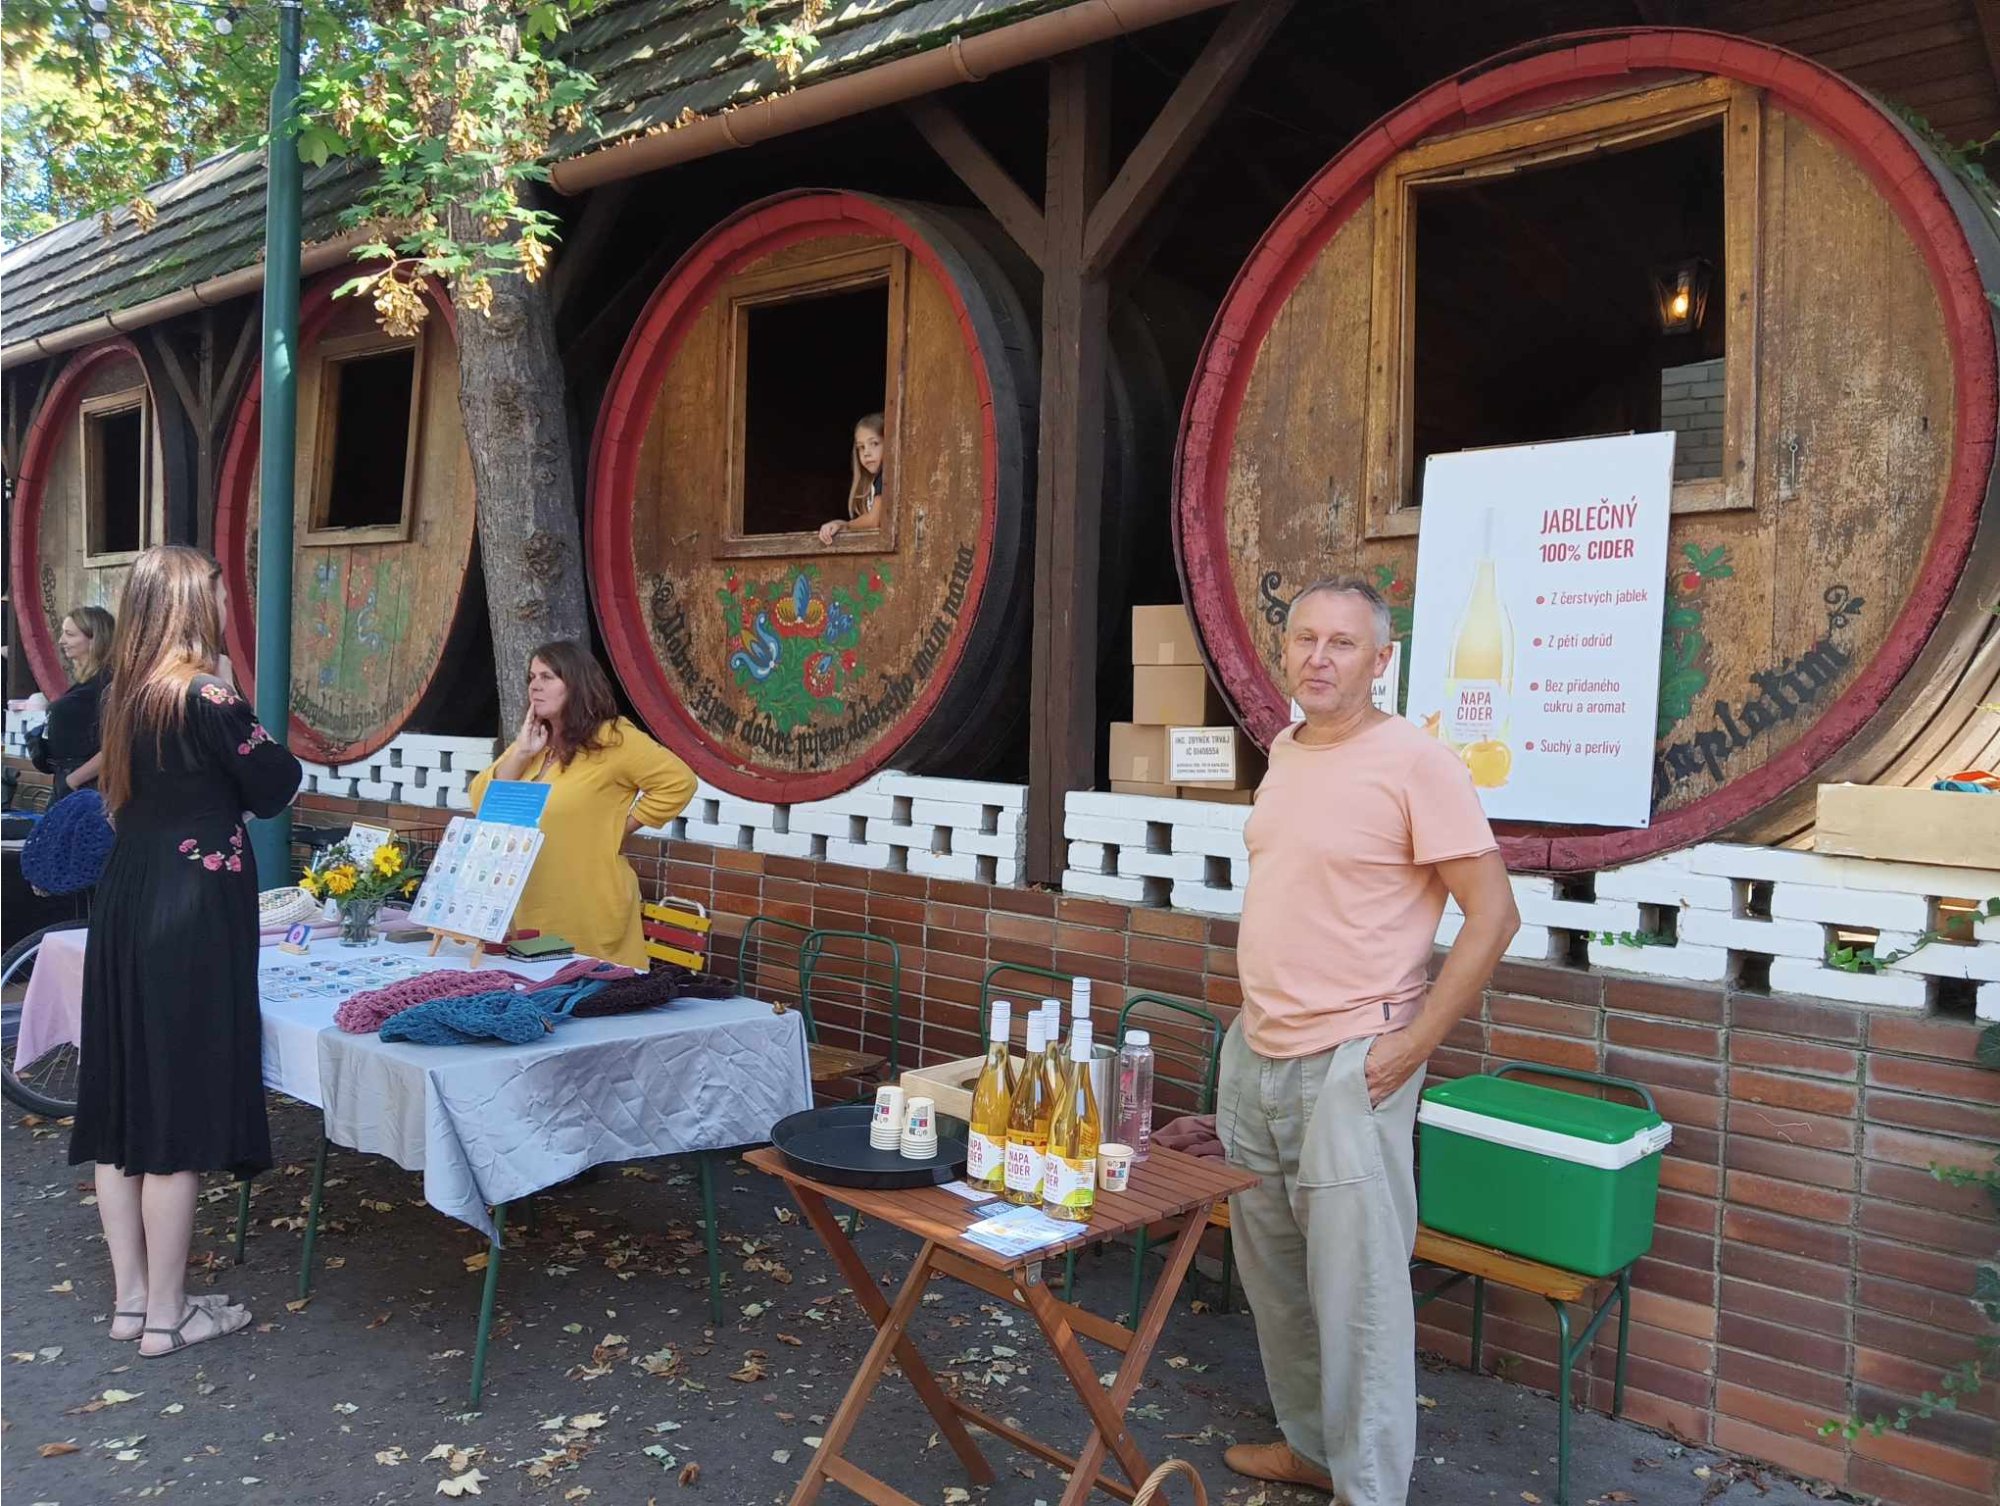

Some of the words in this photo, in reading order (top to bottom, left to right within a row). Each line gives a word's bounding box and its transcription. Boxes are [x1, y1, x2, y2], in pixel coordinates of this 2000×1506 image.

[1540, 495, 1638, 535] JABLEČNÝ
[1539, 542, 1581, 563] 100%
[1587, 538, 1634, 560] CIDER
[1551, 591, 1558, 605] Z
[1560, 589, 1612, 607] čerstvých
[1616, 588, 1648, 605] jablek
[1548, 634, 1555, 648] Z
[1581, 633, 1613, 648] odrůd
[1545, 679, 1564, 693] Bez
[1567, 678, 1620, 695] přidaného
[1461, 691, 1491, 705] NAPA
[1457, 706, 1493, 721] CIDER
[1543, 700, 1573, 713] cukru
[1576, 702, 1583, 713] a
[1586, 701, 1626, 714] aromat
[1540, 739, 1572, 756] Suchý
[1575, 743, 1582, 754] a
[1585, 741, 1622, 758] perlivý
[1008, 1150, 1029, 1165] NAPA
[1008, 1162, 1031, 1177] CIDER
